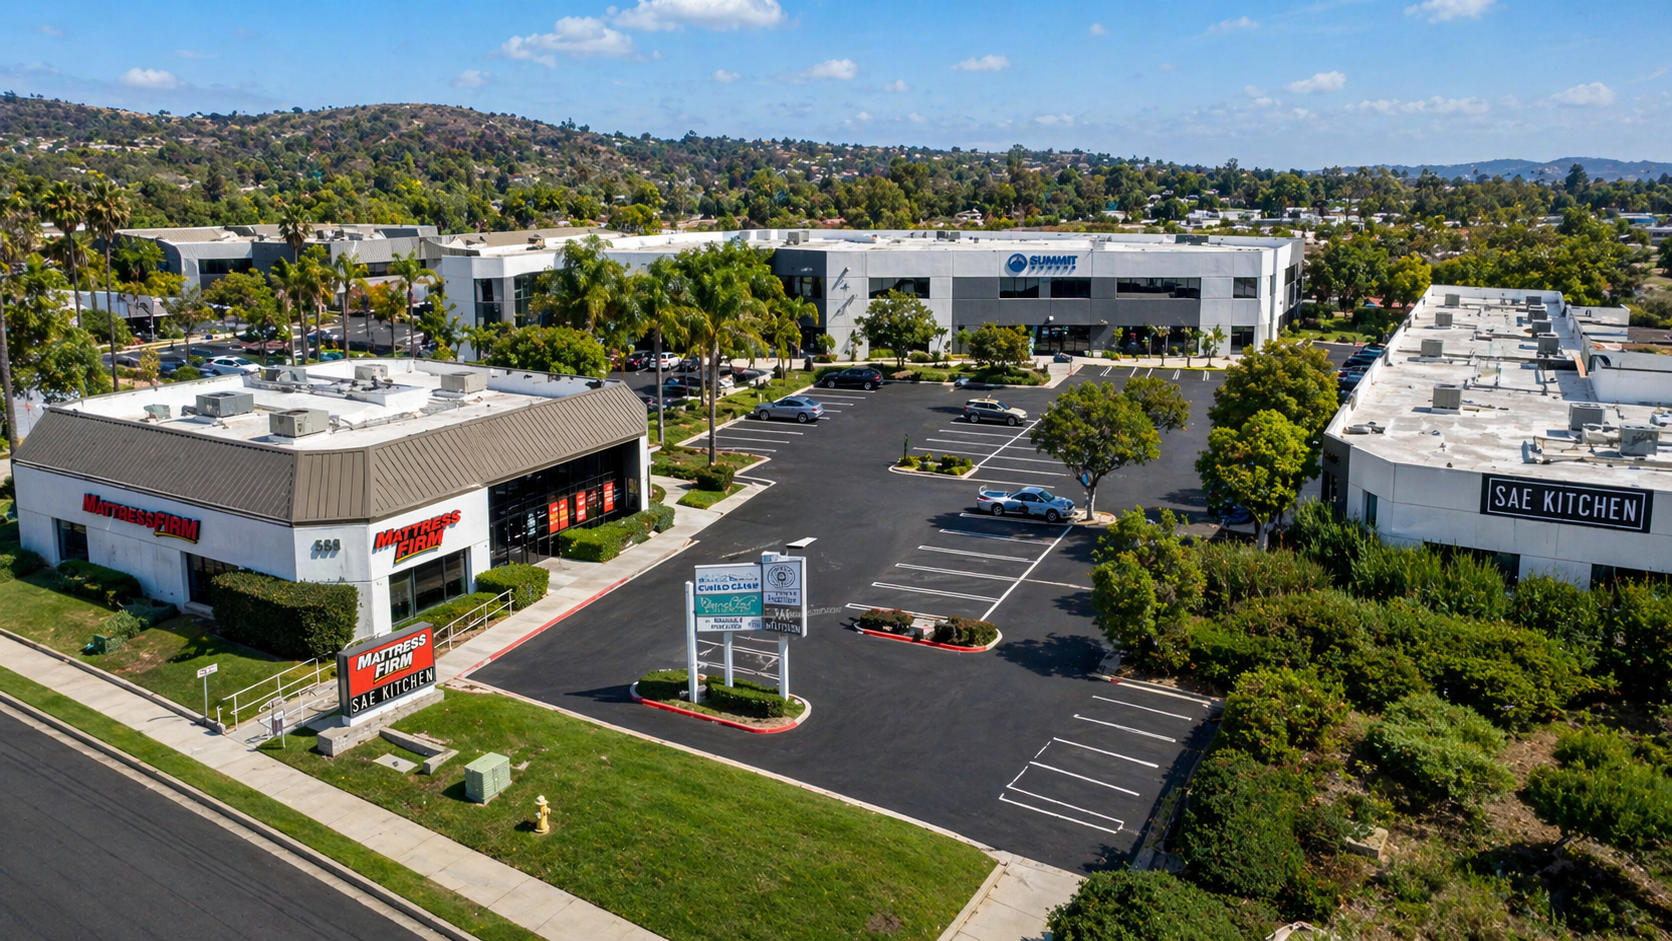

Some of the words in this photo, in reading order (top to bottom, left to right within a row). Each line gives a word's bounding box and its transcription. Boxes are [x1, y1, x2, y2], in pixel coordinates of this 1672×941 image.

[1029, 255, 1078, 266] SUMMIT
[1495, 485, 1533, 510] SAE
[1543, 490, 1637, 522] KITCHEN
[374, 509, 462, 550] MATTRESS
[395, 529, 446, 560] FIRM
[356, 633, 427, 671] MATTRESS
[374, 650, 414, 679] FIRM
[352, 690, 376, 713] SAE
[382, 667, 433, 701] KITCHEN
